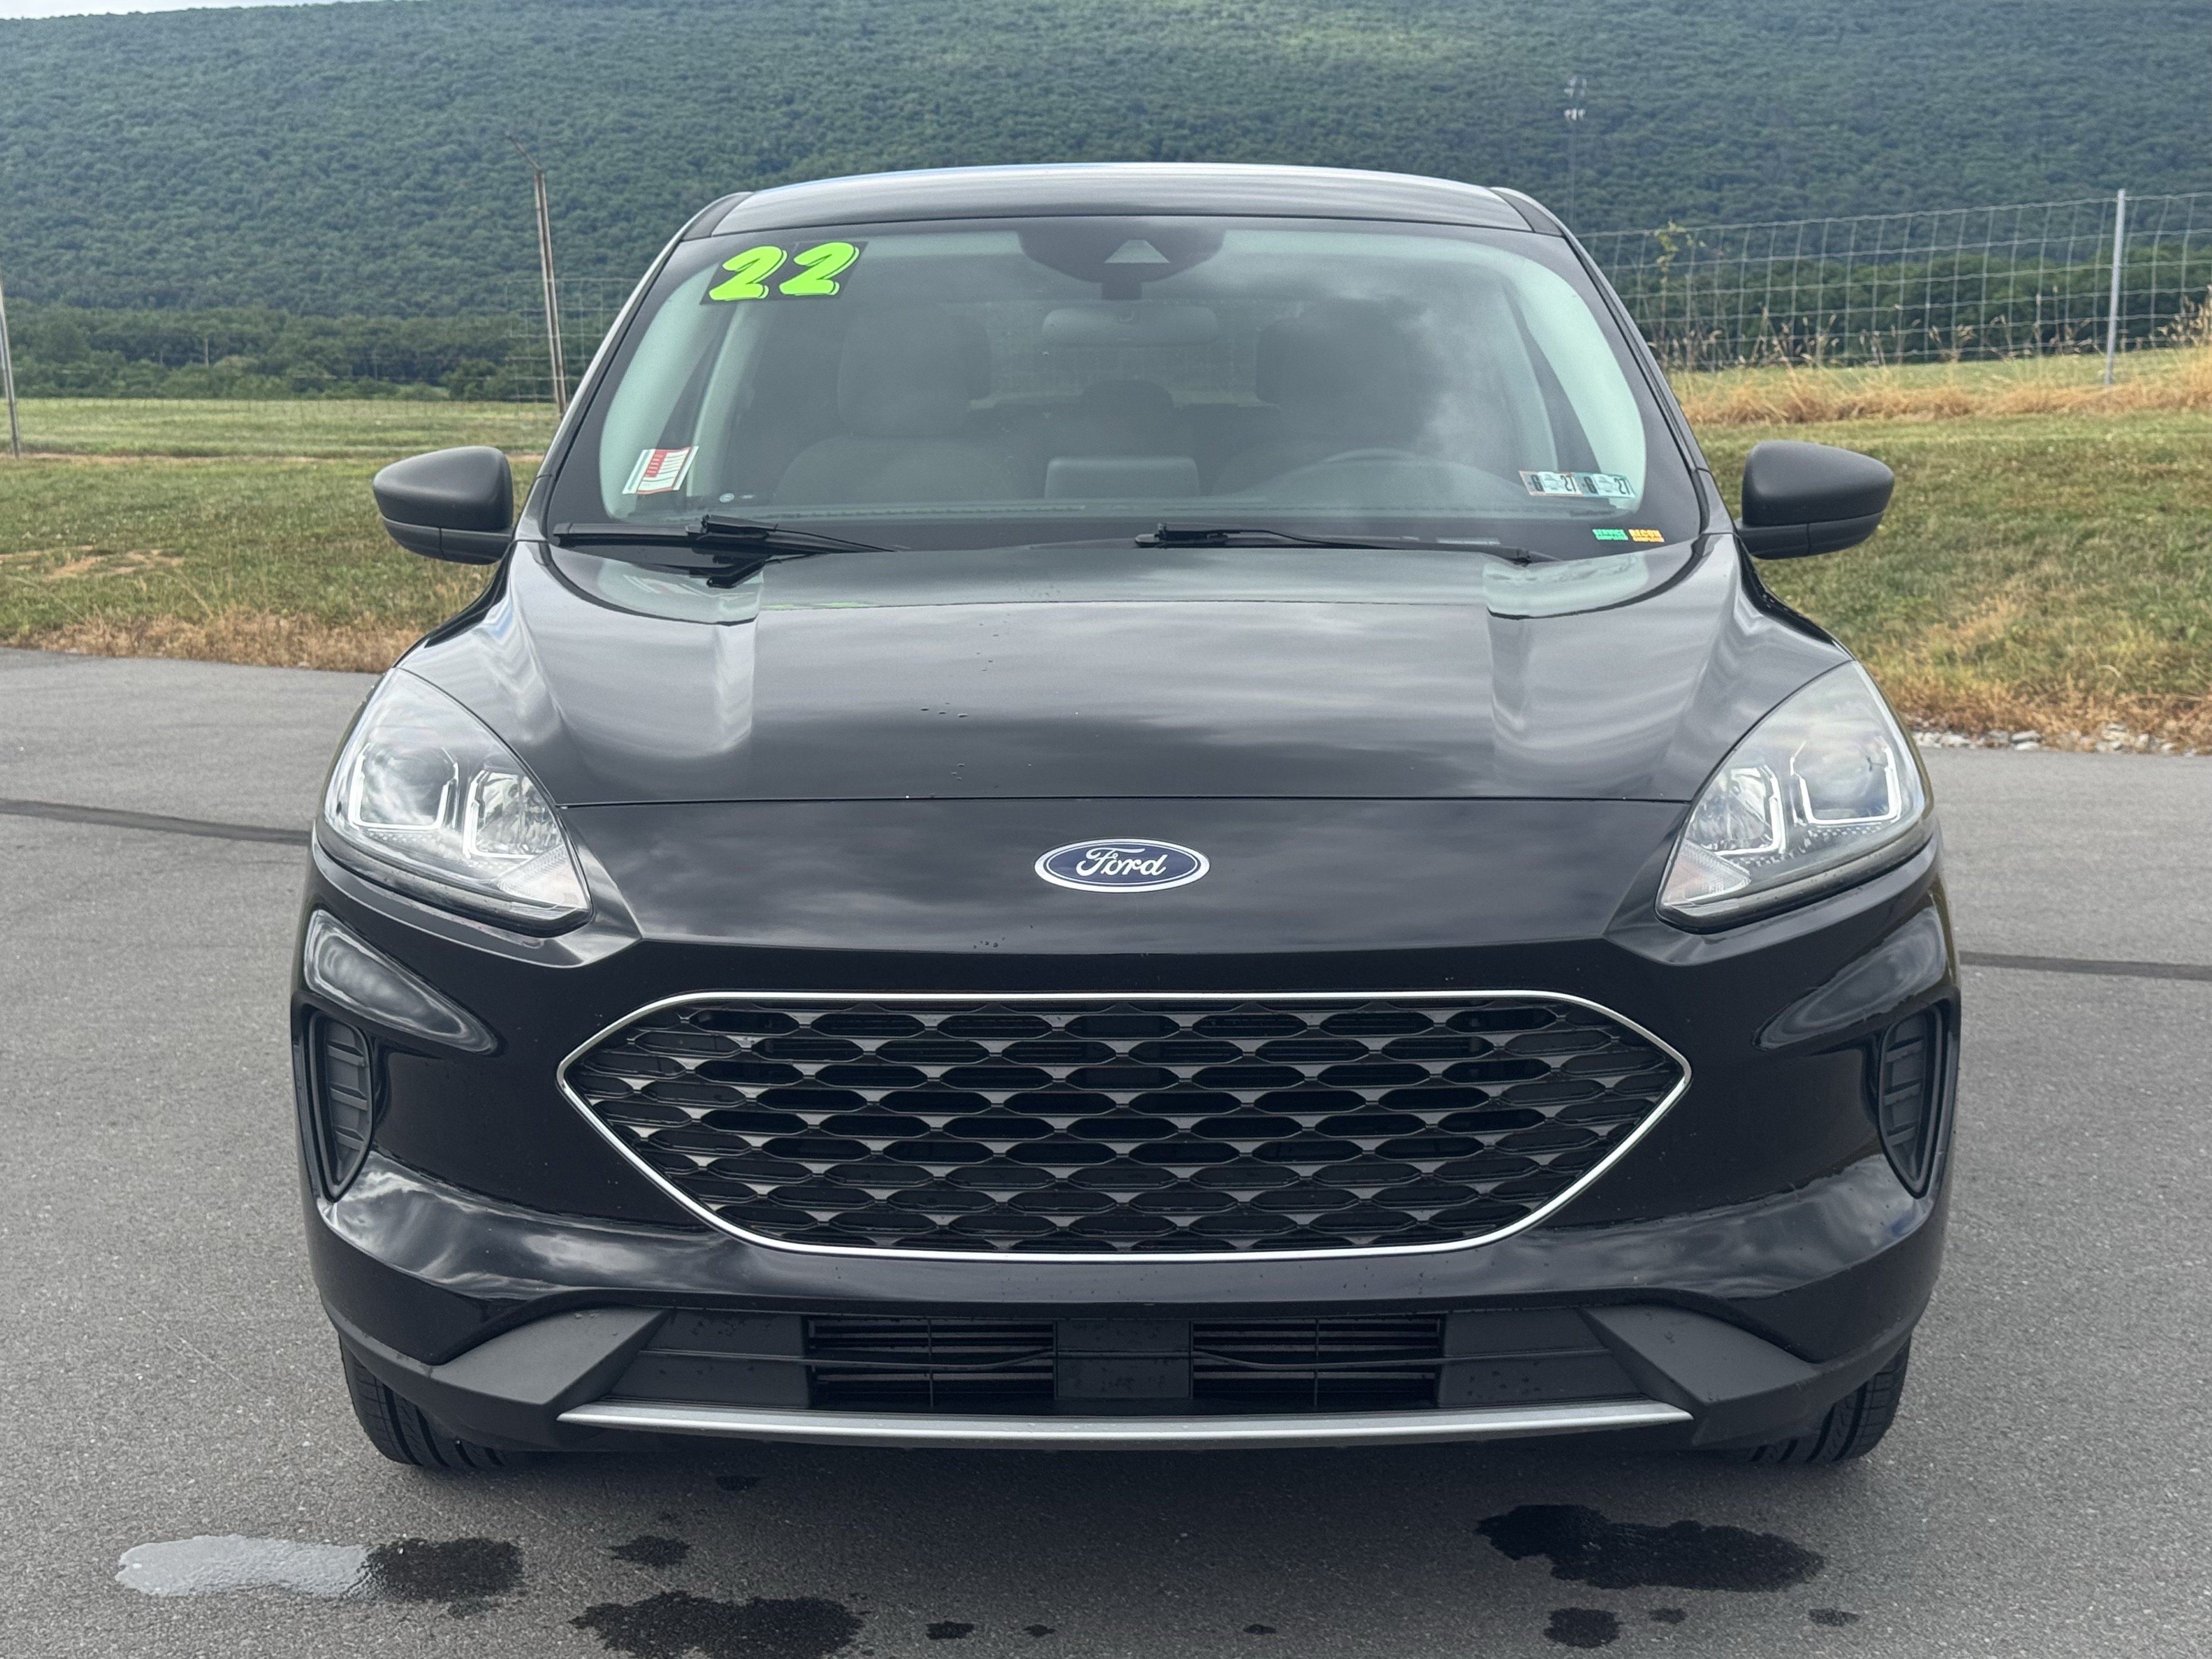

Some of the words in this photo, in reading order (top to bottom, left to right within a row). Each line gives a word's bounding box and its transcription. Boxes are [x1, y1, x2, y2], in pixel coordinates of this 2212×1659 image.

[709, 242, 860, 301] 22
[1560, 475, 1577, 493] 27
[1615, 478, 1630, 495] 27
[1076, 847, 1167, 876] Ford
